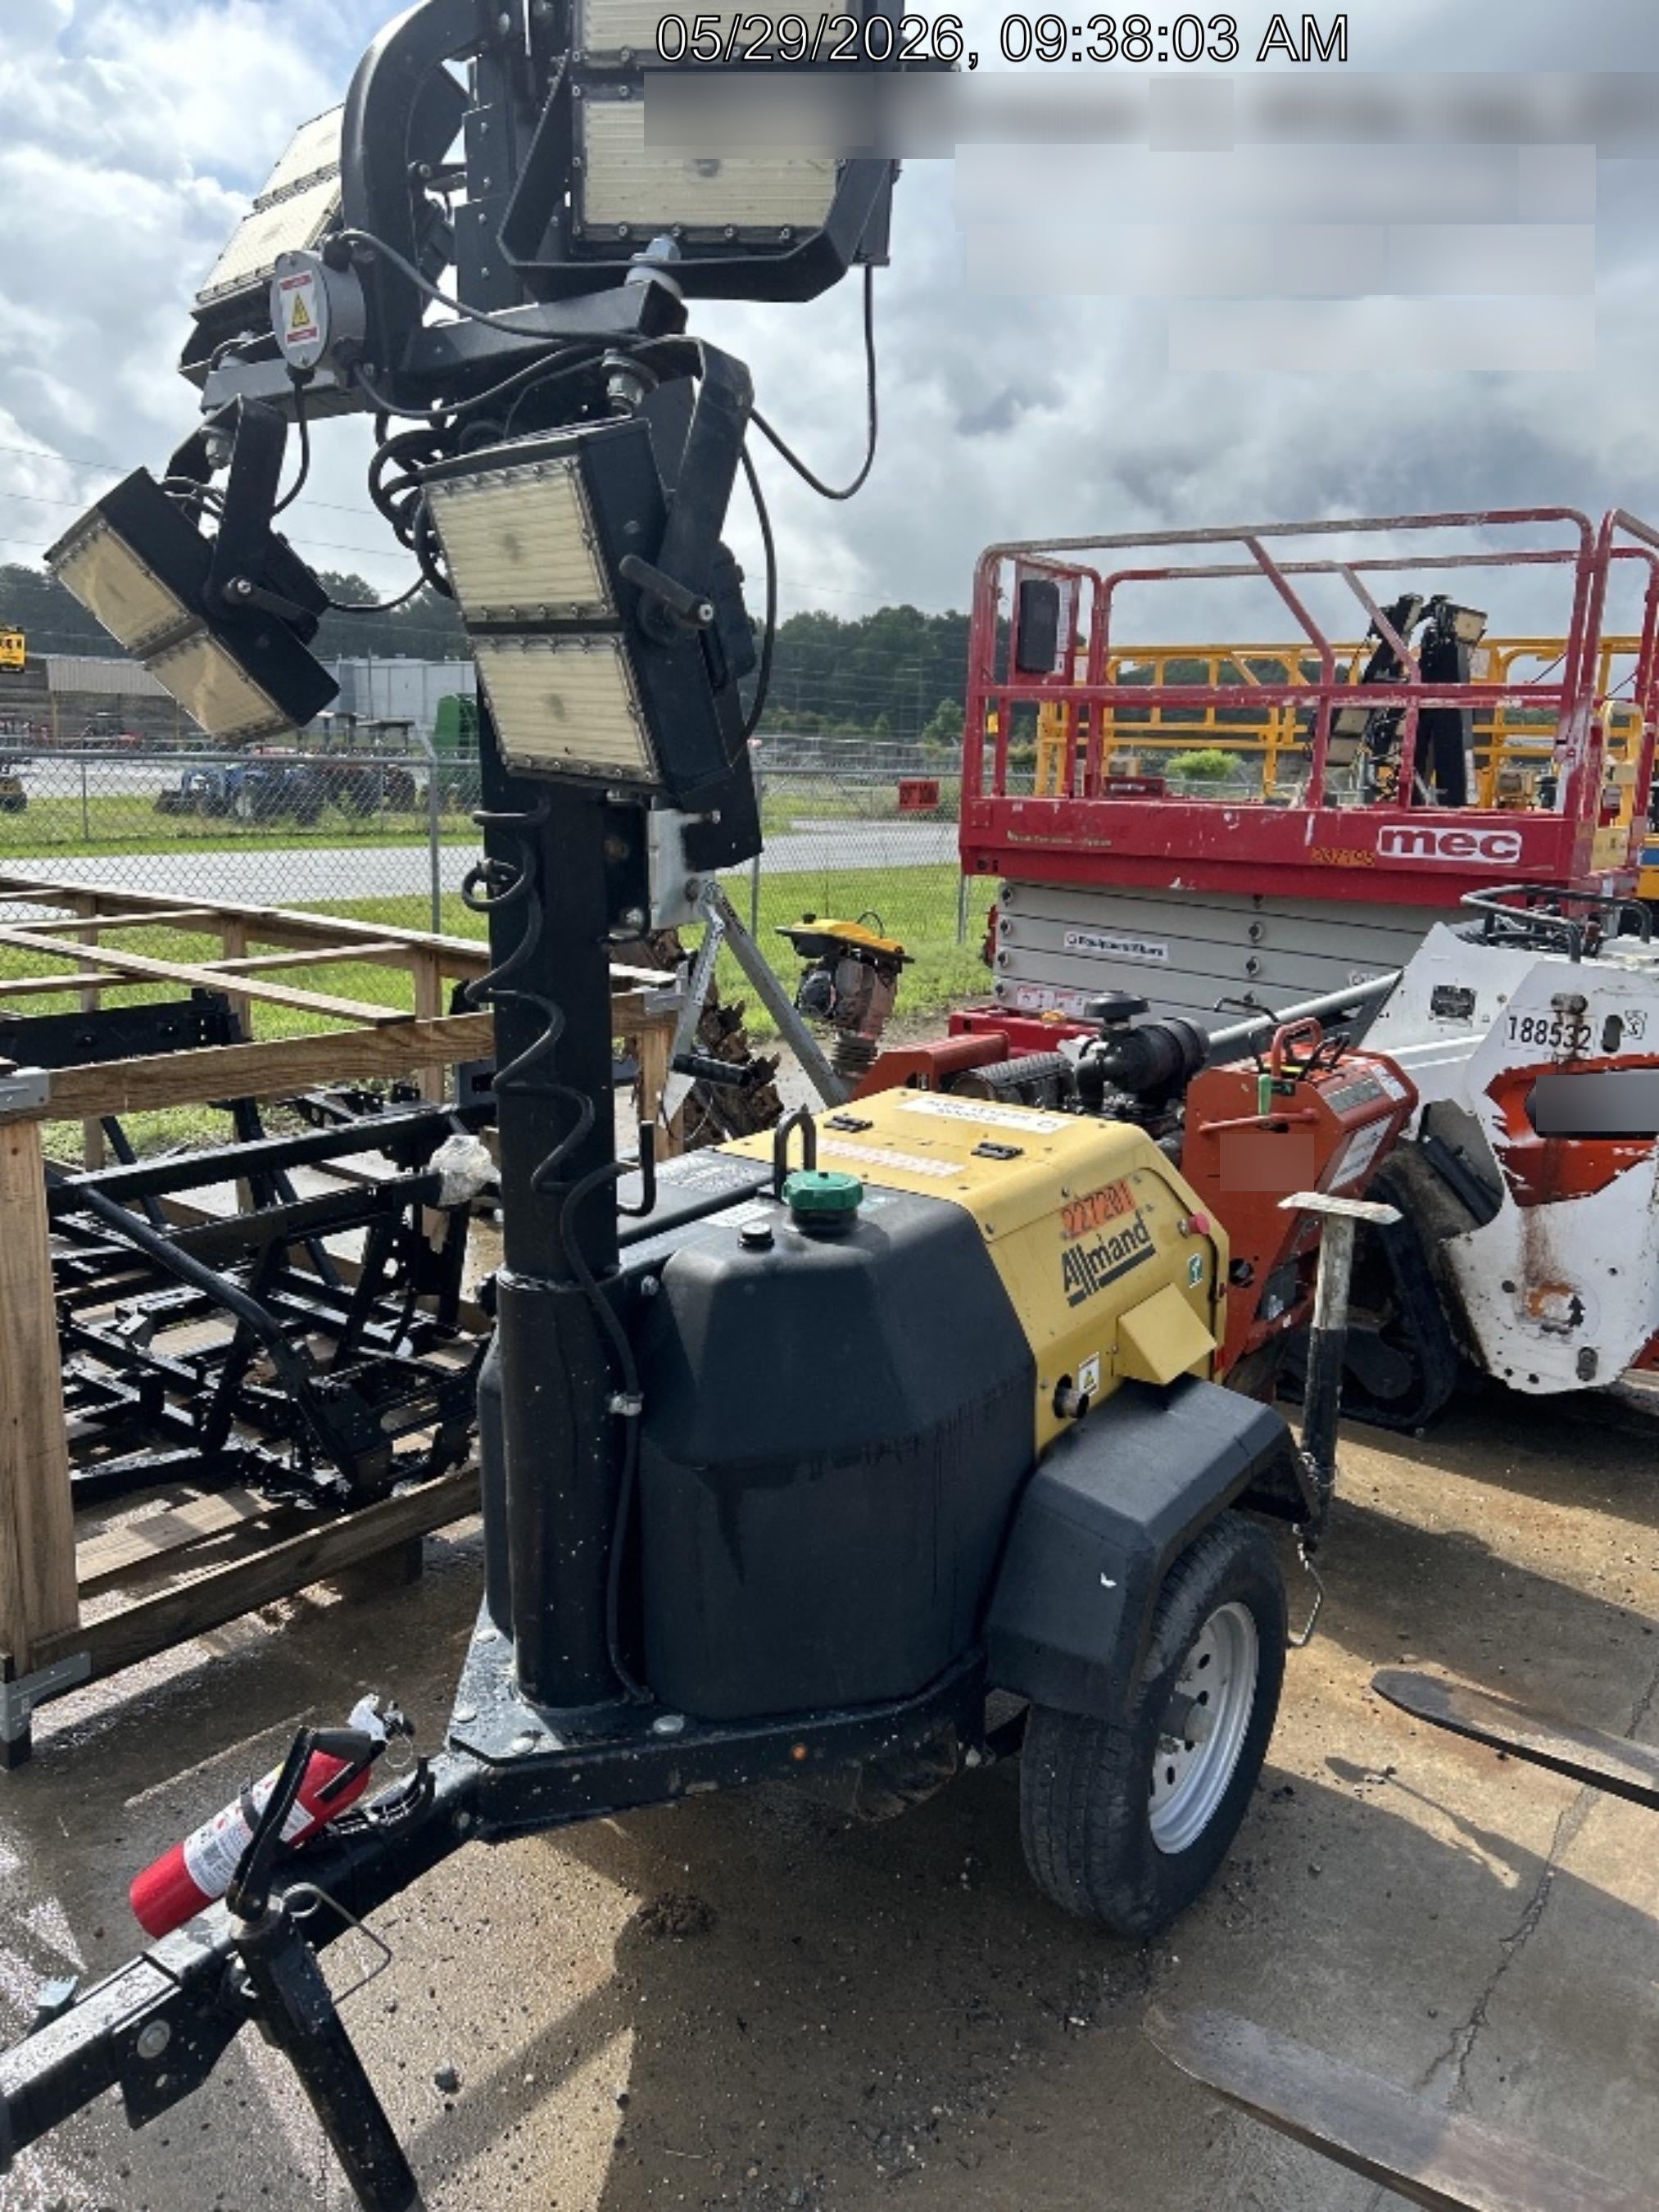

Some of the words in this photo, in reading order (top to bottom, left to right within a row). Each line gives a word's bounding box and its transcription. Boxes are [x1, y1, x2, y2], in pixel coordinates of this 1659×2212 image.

[1381, 829, 1519, 860] mec
[1508, 1016, 1592, 1052] 188532
[1062, 1208, 1151, 1296] Allmand
